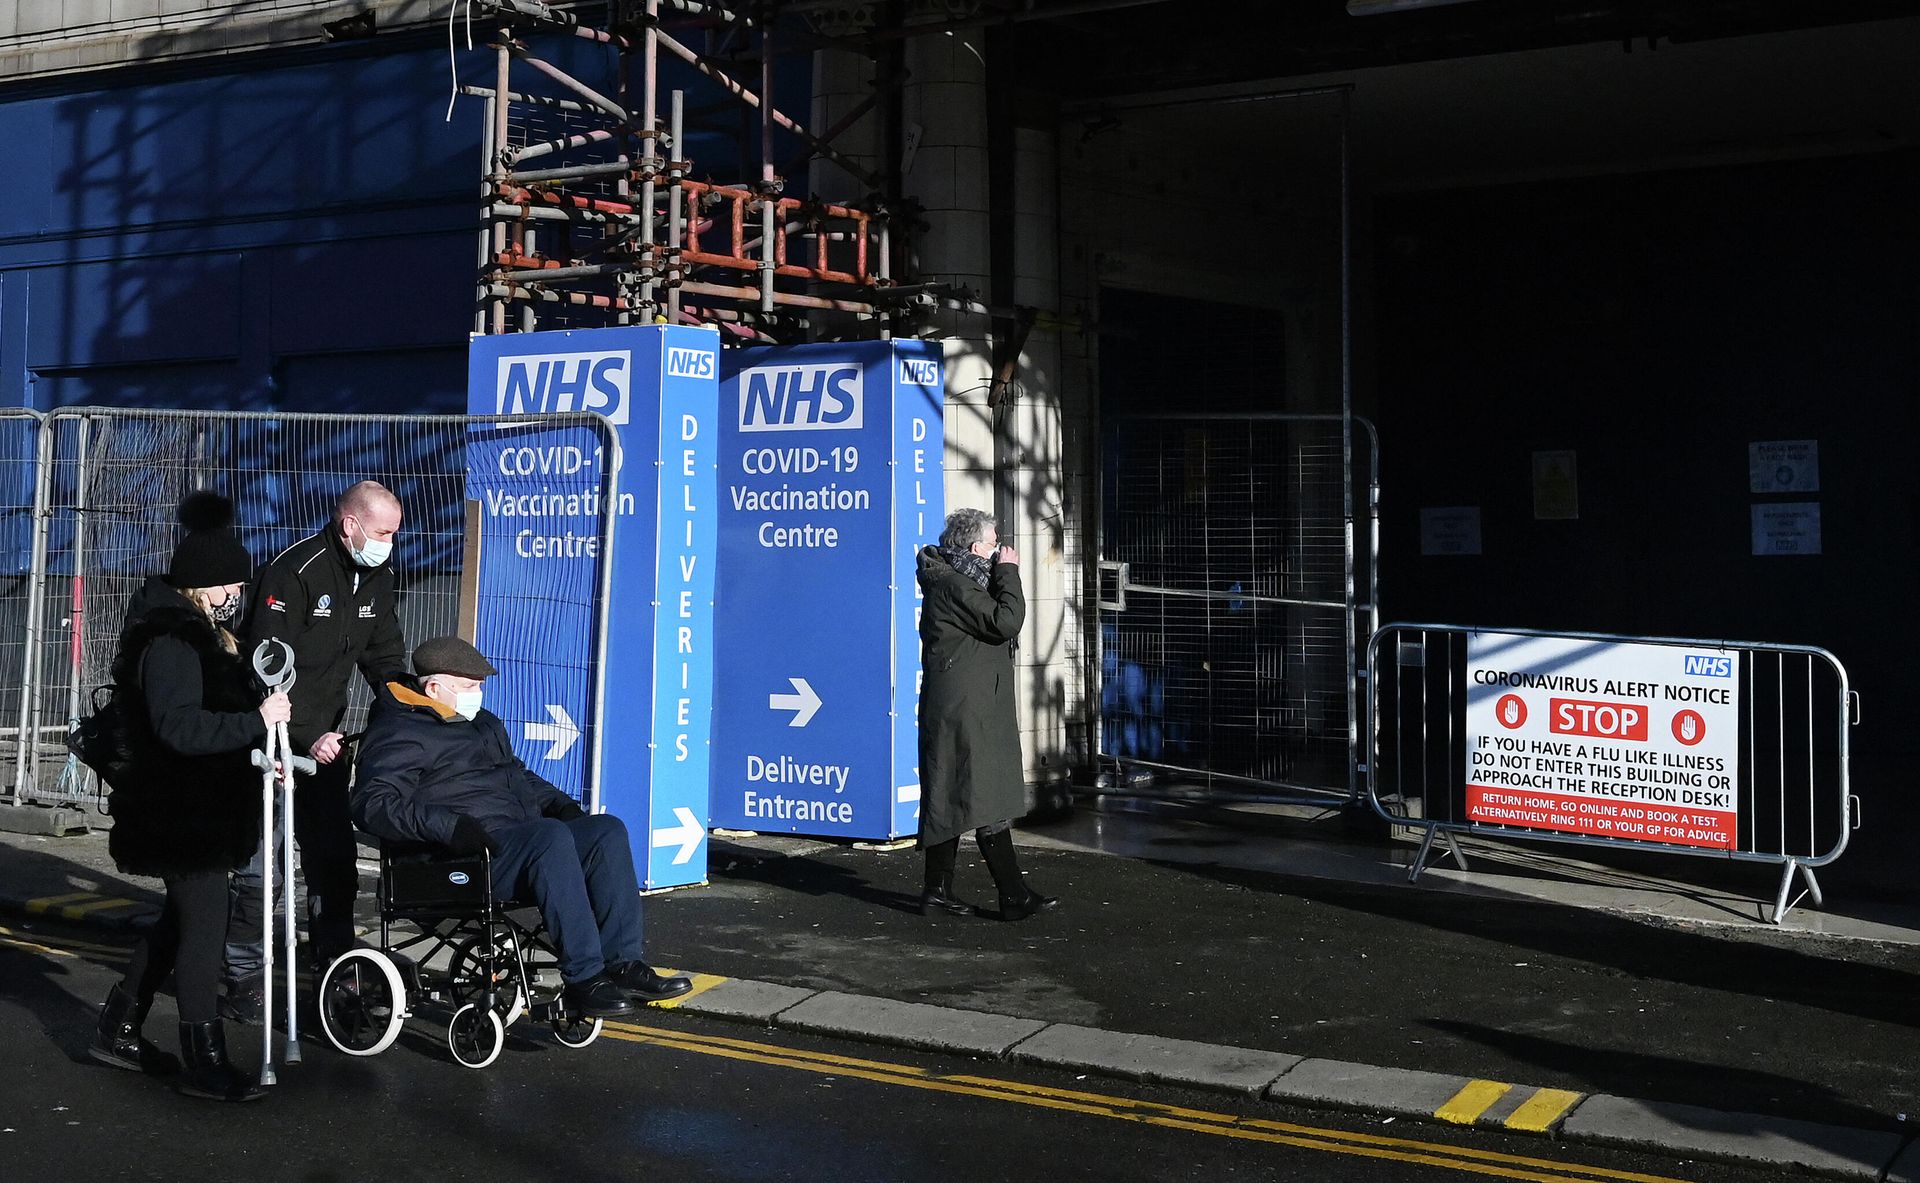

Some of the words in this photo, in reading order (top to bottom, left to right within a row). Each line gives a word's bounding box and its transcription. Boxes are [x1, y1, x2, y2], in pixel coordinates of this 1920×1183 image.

[669, 350, 712, 376] NHS
[901, 360, 936, 383] NHS
[501, 356, 626, 417] NHS
[742, 367, 859, 426] NHS
[741, 446, 860, 475] COVID-19
[729, 482, 870, 512] Vaccination
[515, 528, 600, 558] Centre
[757, 521, 839, 548] Centre
[675, 414, 698, 762] DELIVERIES
[1685, 656, 1729, 677] NHS
[1473, 669, 1598, 694] CORONAVIRUS
[1603, 680, 1659, 699] ALERT
[1664, 684, 1730, 705] NOTICE
[1558, 703, 1639, 736] STOP
[1472, 752, 1495, 766] DO
[1500, 754, 1532, 770] NOT
[1536, 758, 1583, 776] ENTER
[1587, 763, 1621, 779] THIS
[1627, 767, 1702, 787] BUILDING
[1707, 775, 1730, 790] OR
[1478, 735, 1490, 749] IF
[1494, 736, 1526, 753] YOU
[1531, 740, 1572, 757] HAVE
[1576, 745, 1588, 759] A
[1593, 746, 1620, 762] FLU
[1625, 749, 1658, 765] LIKE
[1663, 752, 1724, 772] ILLNESS
[746, 755, 850, 794] Delivery
[1471, 768, 1552, 790] APPROACH
[1557, 777, 1586, 793] THE
[1591, 780, 1676, 803] RECEPTION
[1682, 790, 1730, 808] DESK!
[743, 790, 853, 824] Entrance
[1471, 806, 1548, 823] ALTERNATIVELY
[1550, 814, 1576, 826] RING
[1578, 817, 1594, 828] 111
[1596, 819, 1612, 830] OR
[1614, 821, 1644, 834] YOUR
[1646, 825, 1661, 836] GP
[1663, 827, 1685, 839] FOR
[1687, 830, 1731, 843] ADVICE.
[1482, 792, 1521, 806] RETURN
[1524, 797, 1559, 812] HOME,
[1560, 801, 1577, 812] GO
[1579, 803, 1618, 817] ONLINE
[1620, 808, 1644, 819] AND
[1647, 810, 1679, 823] BOOK
[1680, 814, 1689, 825] A
[1691, 815, 1719, 828] TEST.
